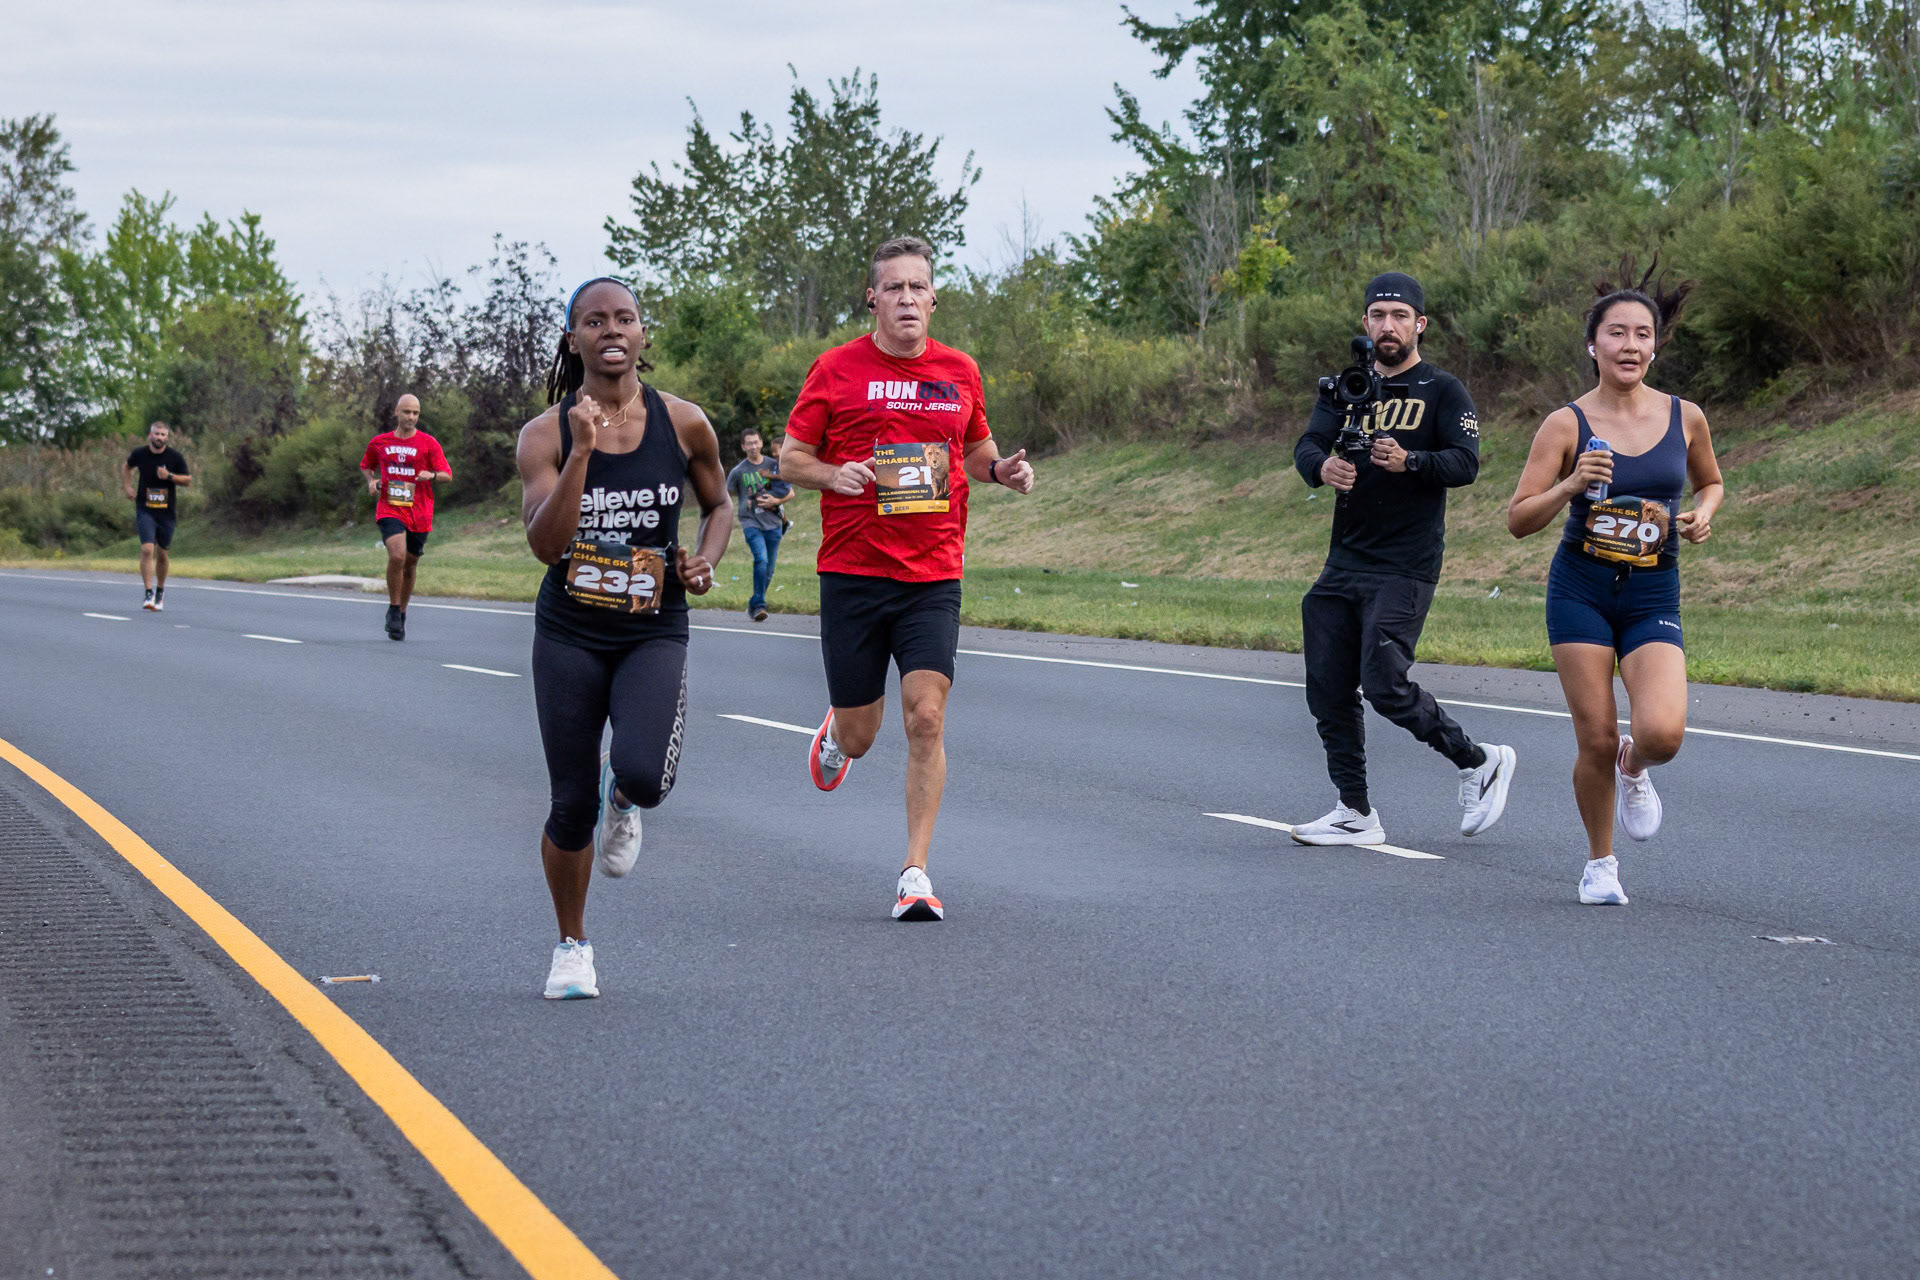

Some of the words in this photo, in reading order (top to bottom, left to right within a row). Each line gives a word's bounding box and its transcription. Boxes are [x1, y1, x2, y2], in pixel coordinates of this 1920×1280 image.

[886, 401, 922, 410] SOUTH
[925, 402, 961, 412] JERSEY
[385, 445, 417, 457] LEONIA
[875, 456, 909, 465] CHASE
[388, 466, 416, 476] CLUB
[898, 465, 933, 487] 21
[390, 487, 411, 498] 104
[580, 487, 655, 512] elieve
[658, 483, 679, 506] to
[1591, 505, 1624, 515] CHASE
[578, 509, 660, 529] chieve
[1592, 514, 1660, 543] 270
[575, 542, 597, 552] THE
[573, 552, 611, 565] CHASE
[574, 564, 656, 598] 232
